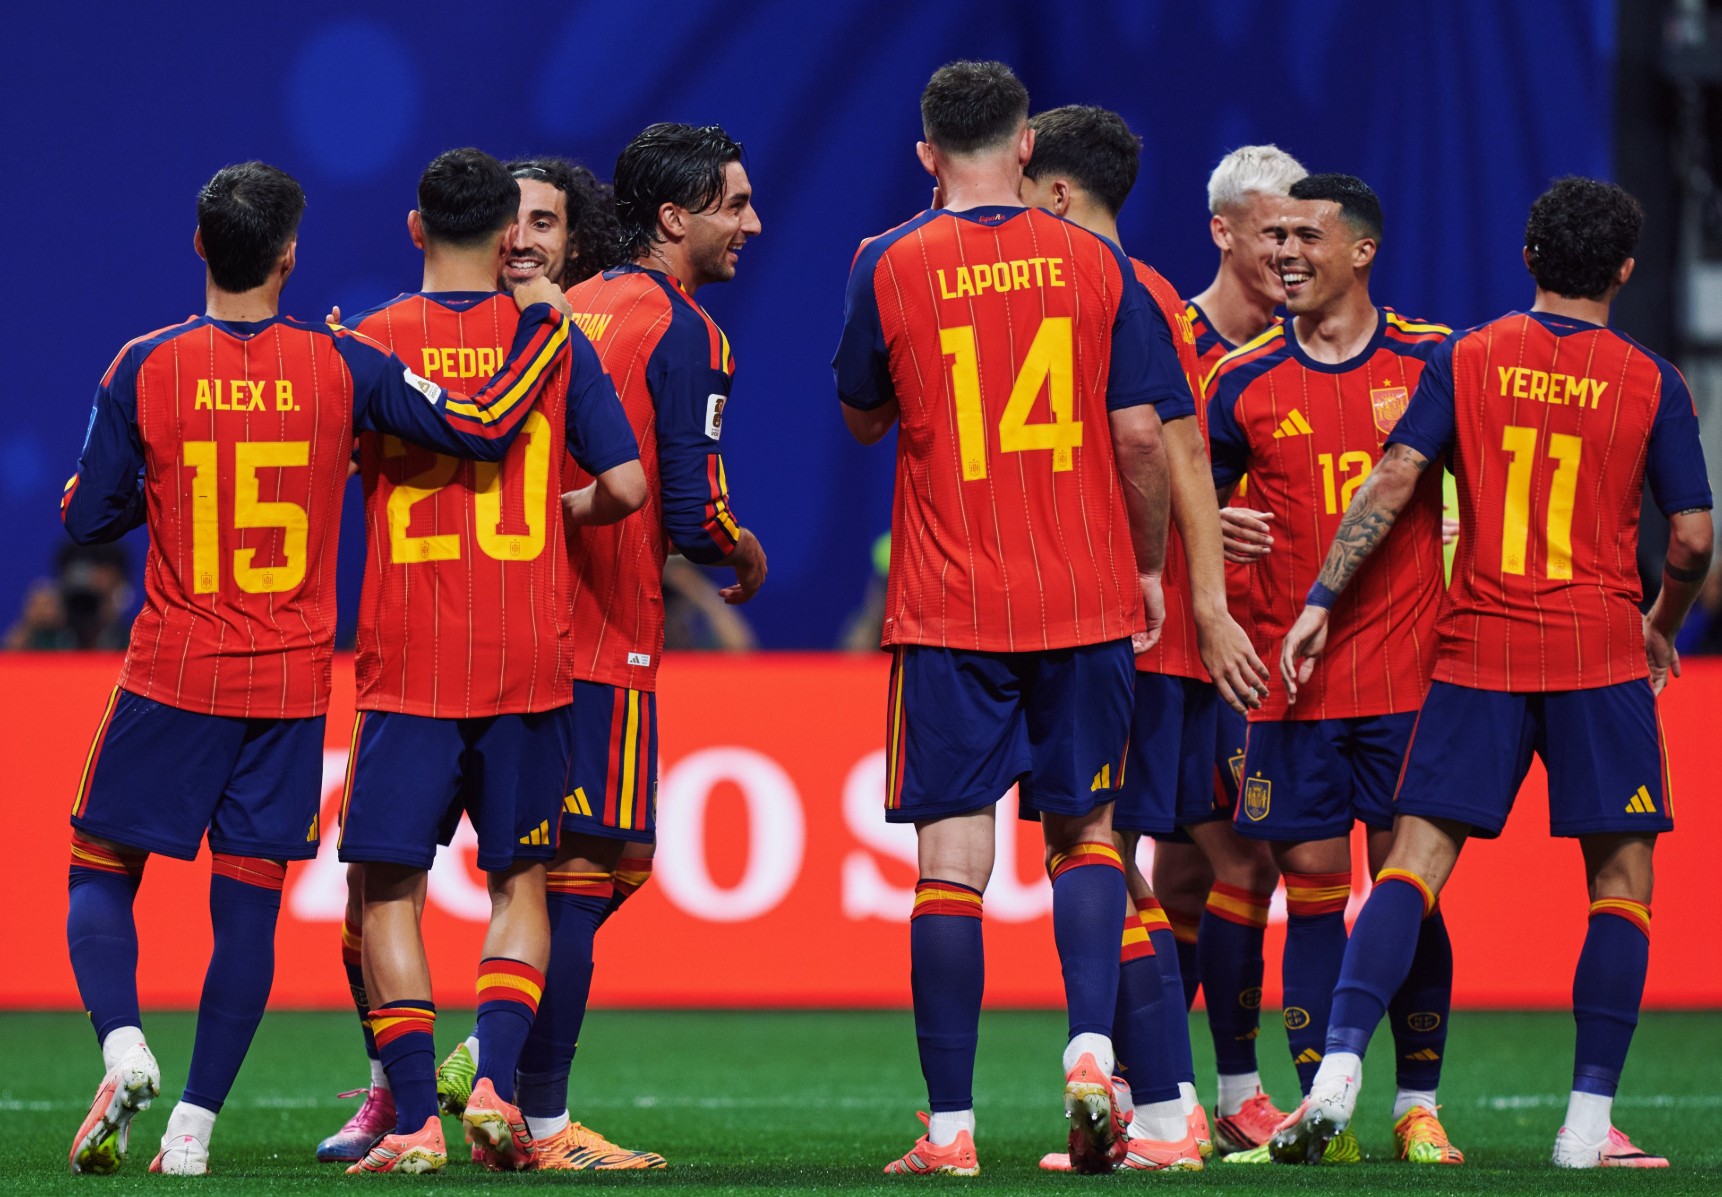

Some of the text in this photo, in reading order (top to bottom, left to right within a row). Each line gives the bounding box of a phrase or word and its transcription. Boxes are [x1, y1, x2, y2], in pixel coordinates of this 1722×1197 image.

[937, 257, 1066, 300] LAPORTE
[194, 379, 300, 412] ALEX B.
[939, 316, 1083, 482] 14
[1497, 366, 1608, 410] YEREMY
[183, 441, 310, 594] 15
[386, 409, 551, 564] 20
[1318, 450, 1373, 515] 12
[1502, 425, 1583, 580] 11
